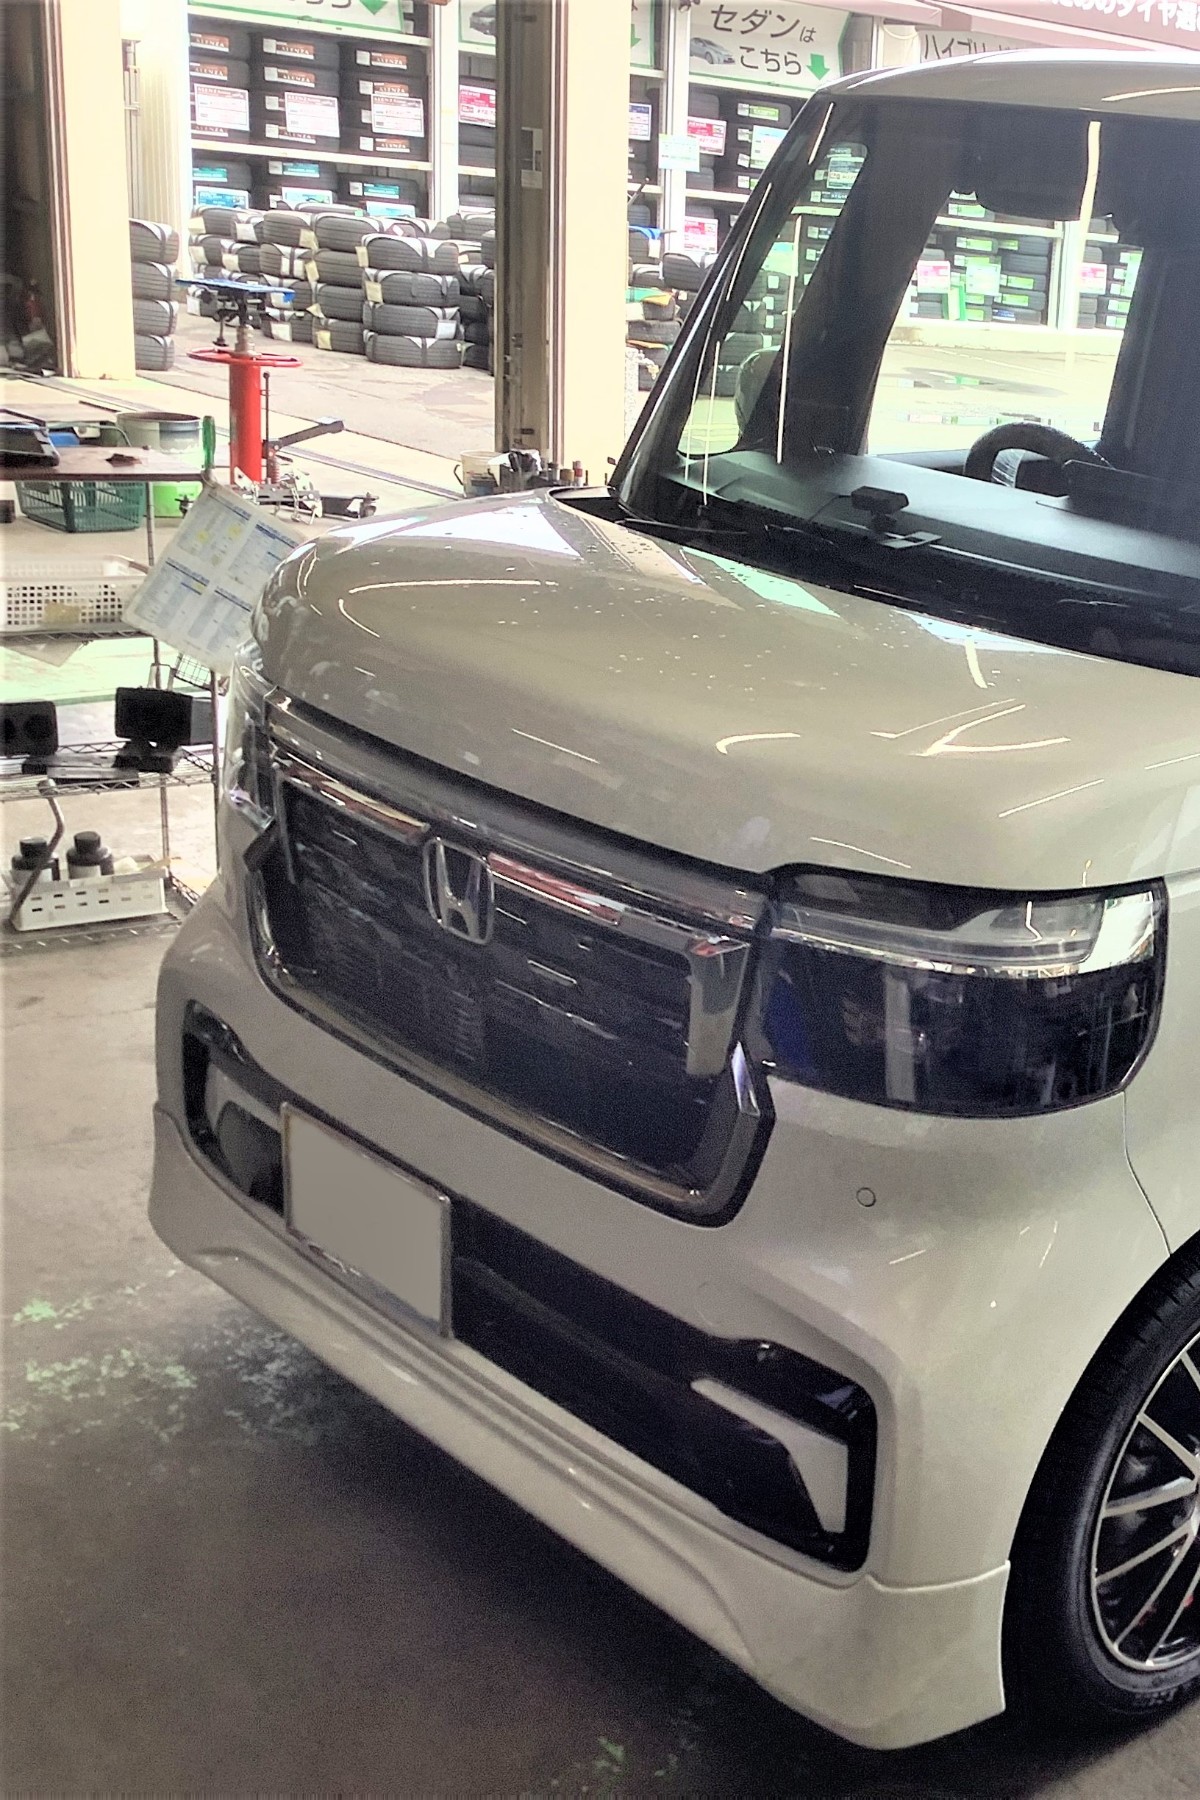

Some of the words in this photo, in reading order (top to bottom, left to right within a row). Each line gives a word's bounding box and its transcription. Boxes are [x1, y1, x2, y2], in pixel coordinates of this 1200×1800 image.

[711, 4, 815, 43] セダンは
[739, 45, 802, 76] こちら
